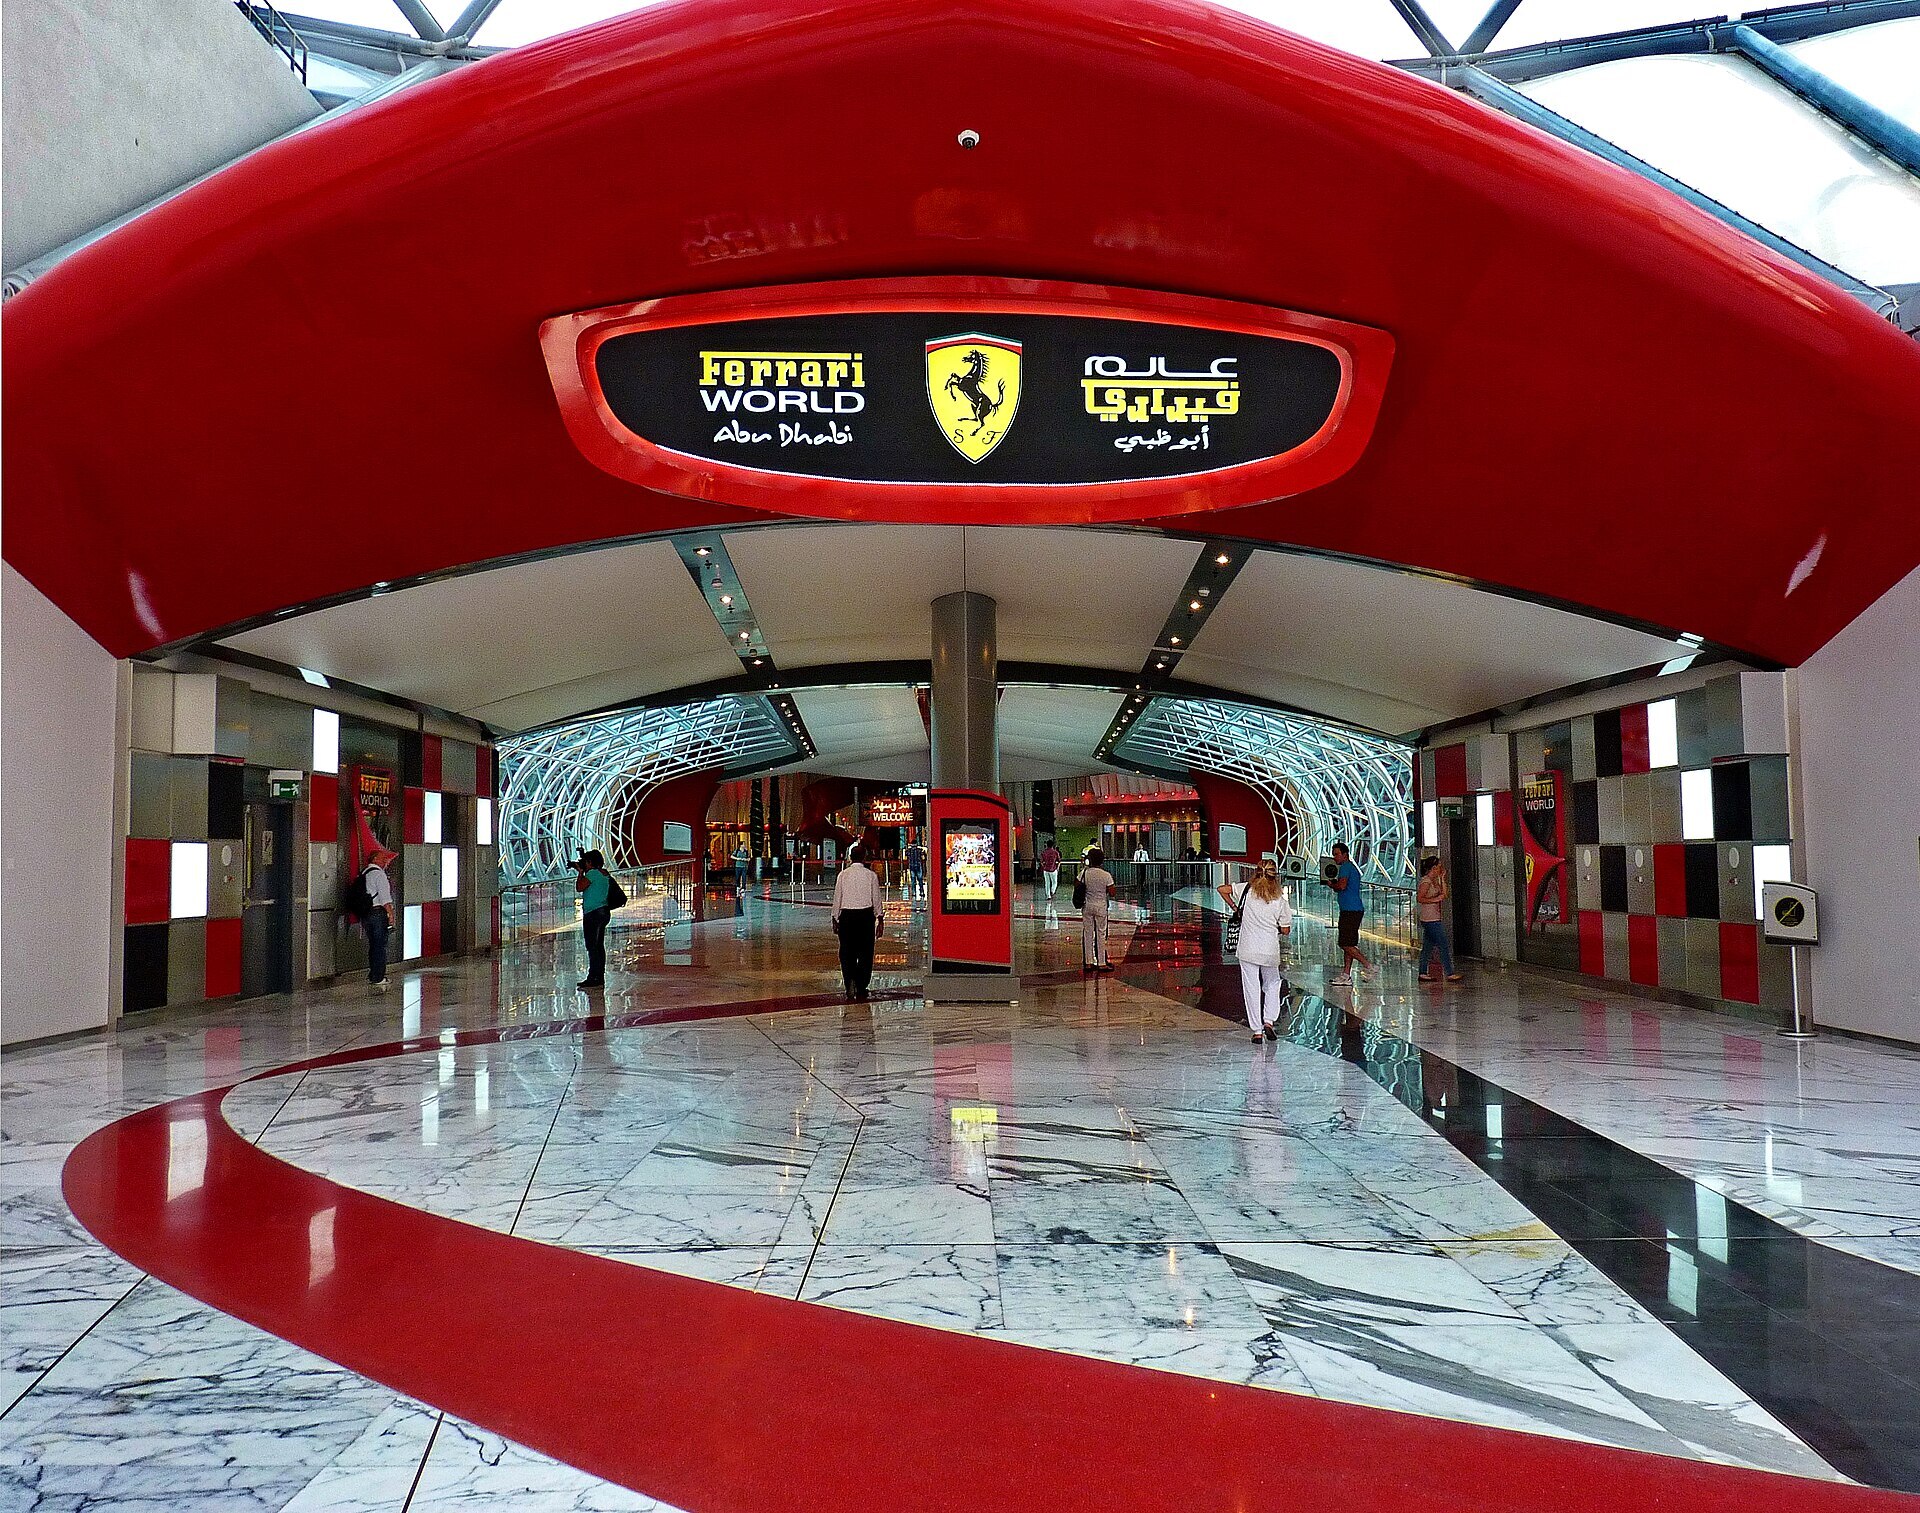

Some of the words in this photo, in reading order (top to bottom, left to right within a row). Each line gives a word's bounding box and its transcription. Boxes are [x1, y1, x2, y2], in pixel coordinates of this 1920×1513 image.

[699, 351, 866, 388] Ferrari
[1084, 355, 1238, 378] عالم
[699, 389, 866, 414] WORLD
[1080, 378, 1241, 423] فيراري
[713, 419, 773, 444] Abu
[778, 420, 854, 448] Dhabi
[953, 428, 965, 444] S
[1113, 428, 1172, 453] ظبي
[1168, 424, 1210, 451] أبو
[360, 793, 390, 807] WORLD
[1525, 798, 1555, 811] WORLD
[872, 812, 914, 822] WELCOME
